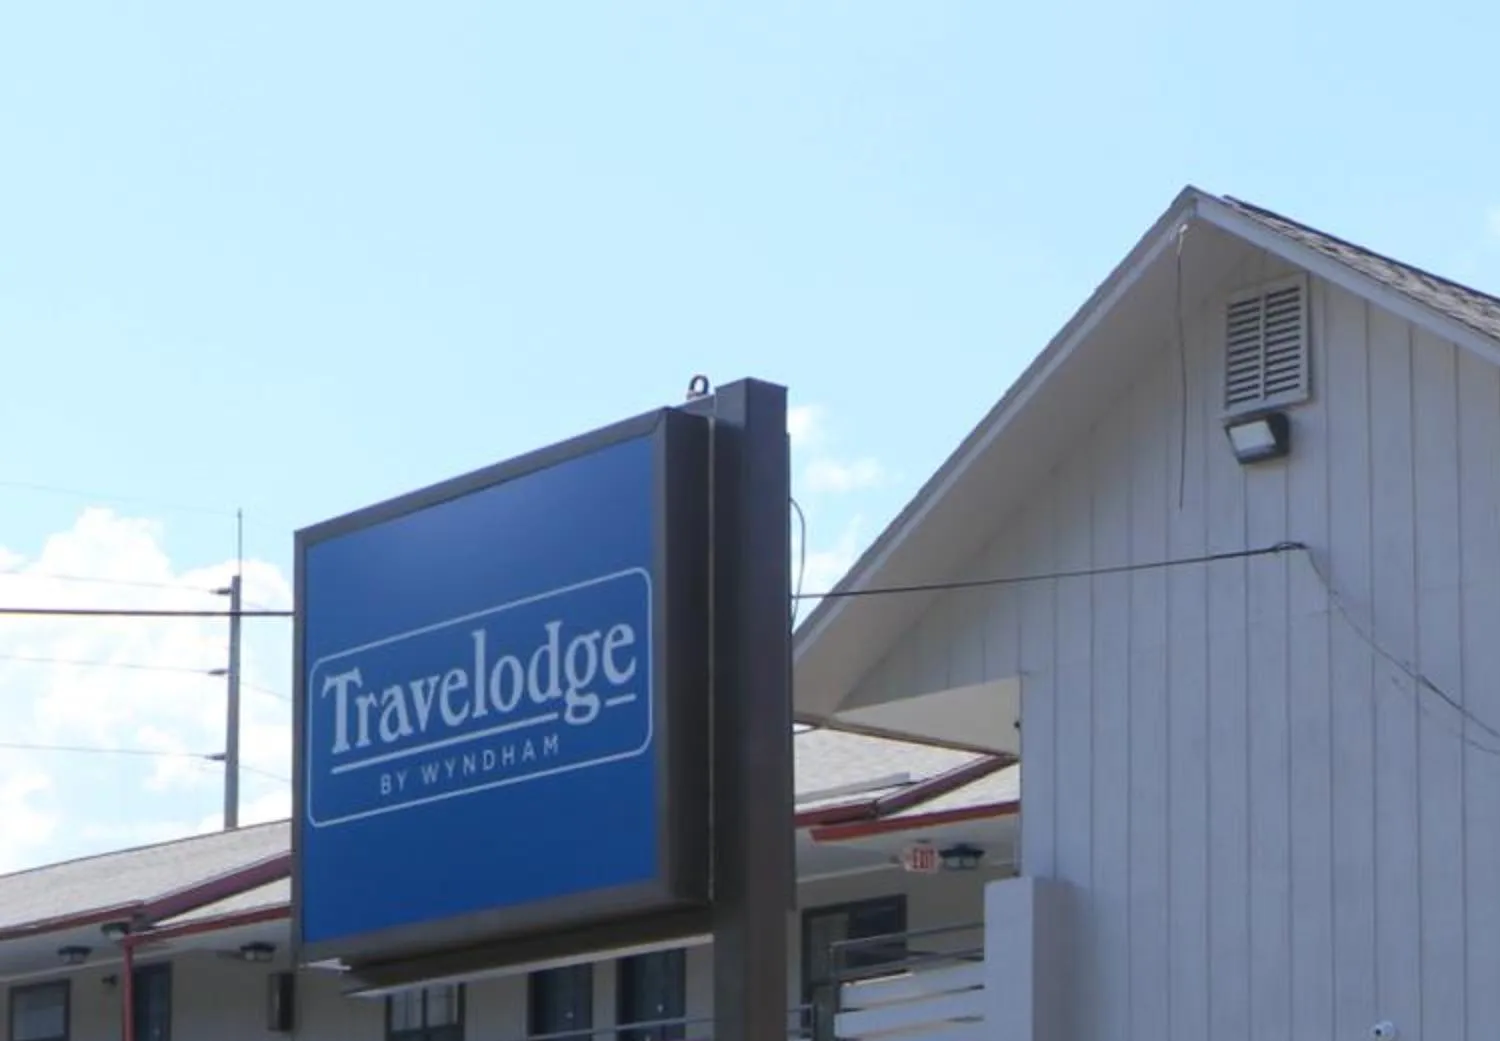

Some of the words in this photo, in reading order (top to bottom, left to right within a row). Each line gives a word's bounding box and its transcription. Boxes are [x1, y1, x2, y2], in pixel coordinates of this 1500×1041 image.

[321, 620, 637, 755] Travelodge
[379, 772, 406, 796] BY
[421, 733, 560, 785] WYNDHAM
